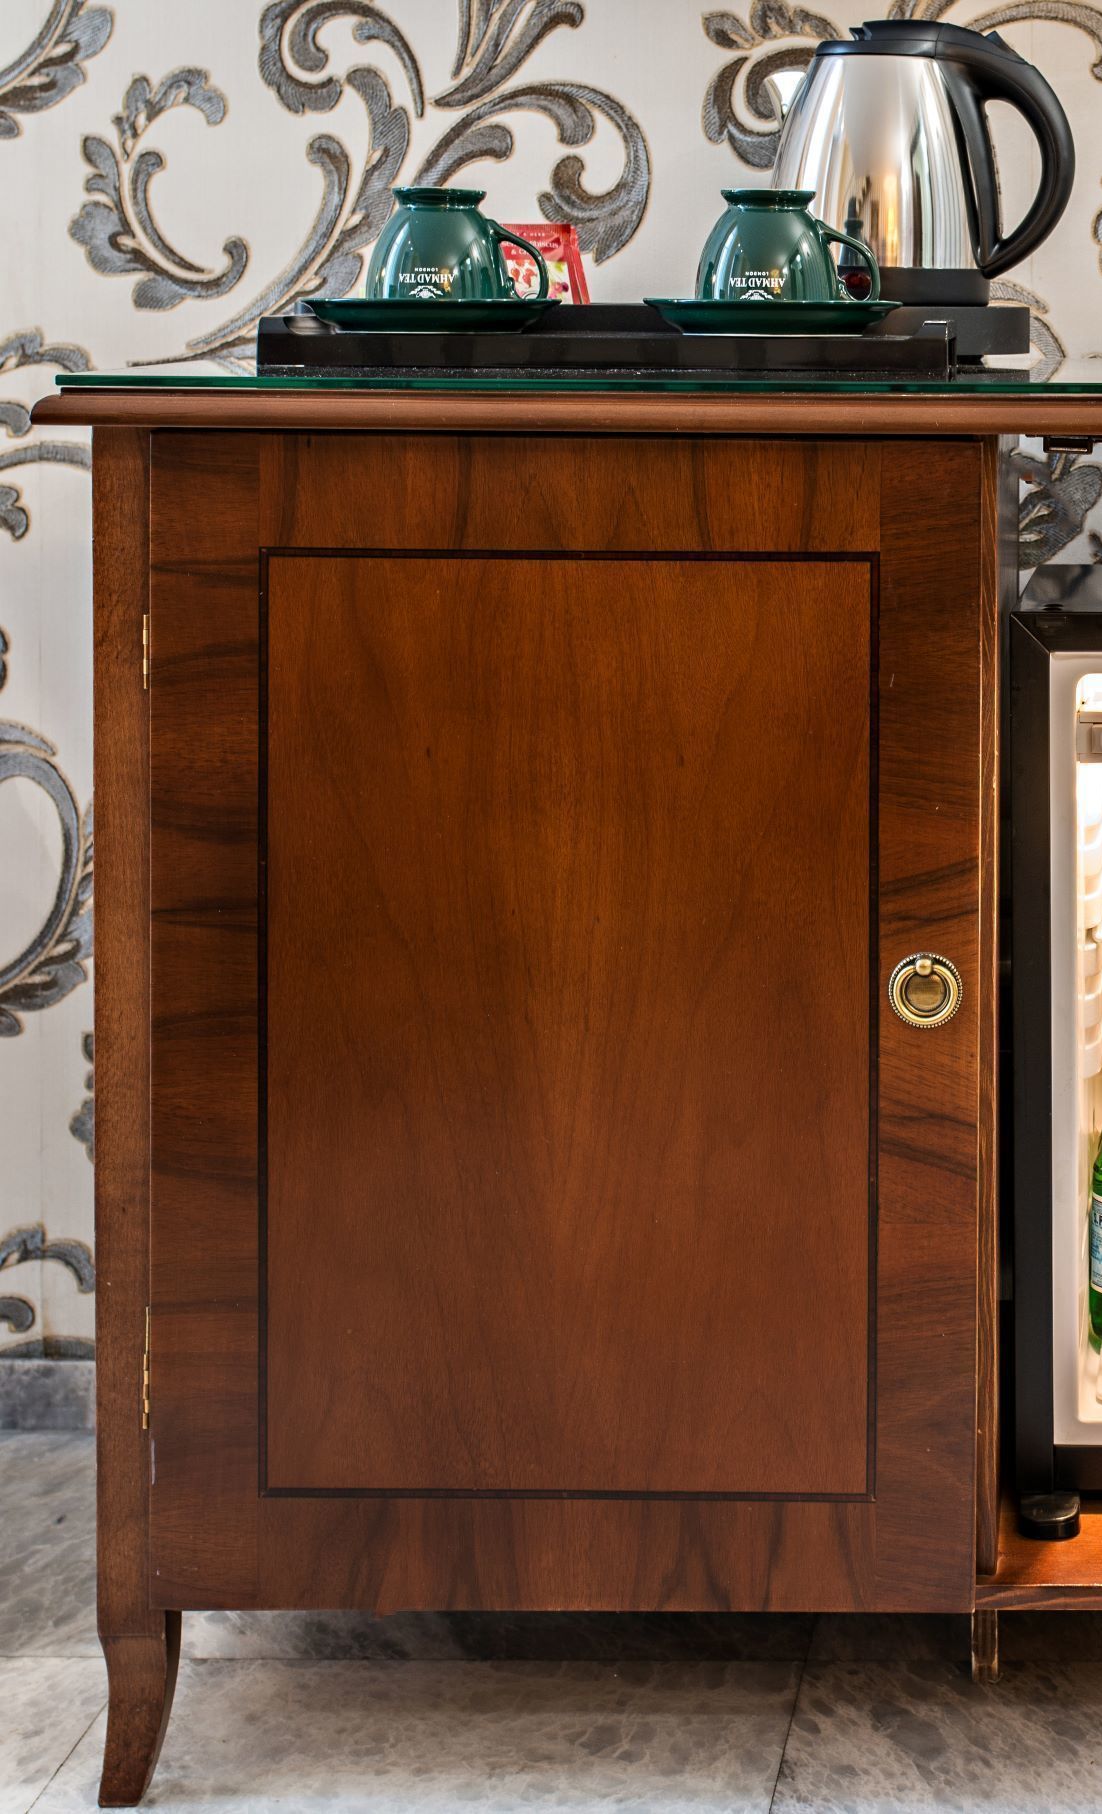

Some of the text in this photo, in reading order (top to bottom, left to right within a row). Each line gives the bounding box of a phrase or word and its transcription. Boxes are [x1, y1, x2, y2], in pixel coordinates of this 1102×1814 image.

[399, 273, 455, 283] AHMAD TEA
[730, 277, 786, 288] AHMAD TEA
